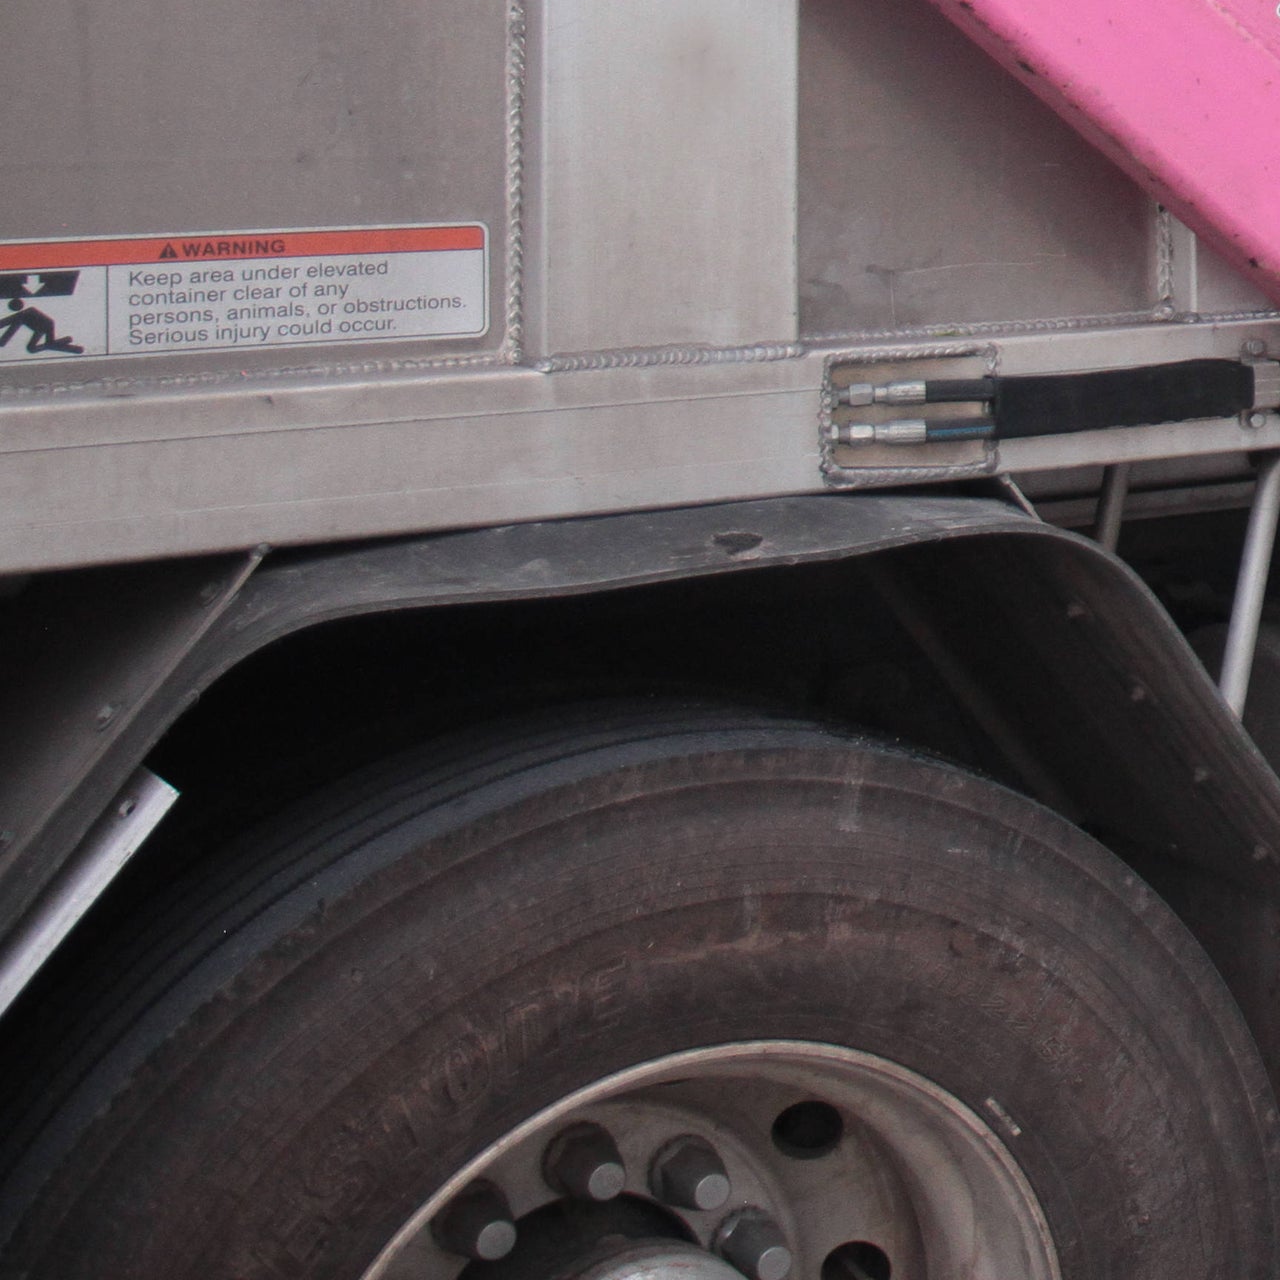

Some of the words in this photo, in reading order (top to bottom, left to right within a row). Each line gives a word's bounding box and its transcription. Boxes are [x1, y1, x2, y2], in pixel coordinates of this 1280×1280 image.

[182, 239, 286, 257] WARNING
[129, 270, 183, 288] Keep
[189, 269, 234, 284] area
[241, 265, 300, 281] under
[306, 260, 389, 278] elevated
[128, 288, 227, 306] container
[233, 285, 282, 301] clear
[289, 282, 308, 298] of
[314, 283, 350, 299] any
[129, 309, 220, 329] persons,
[227, 302, 311, 321] animals,
[317, 302, 338, 316] or
[343, 295, 467, 313] obstructions.
[129, 328, 209, 345] Serious
[215, 324, 271, 343] injury
[277, 319, 332, 336] could
[338, 319, 397, 333] occur.
